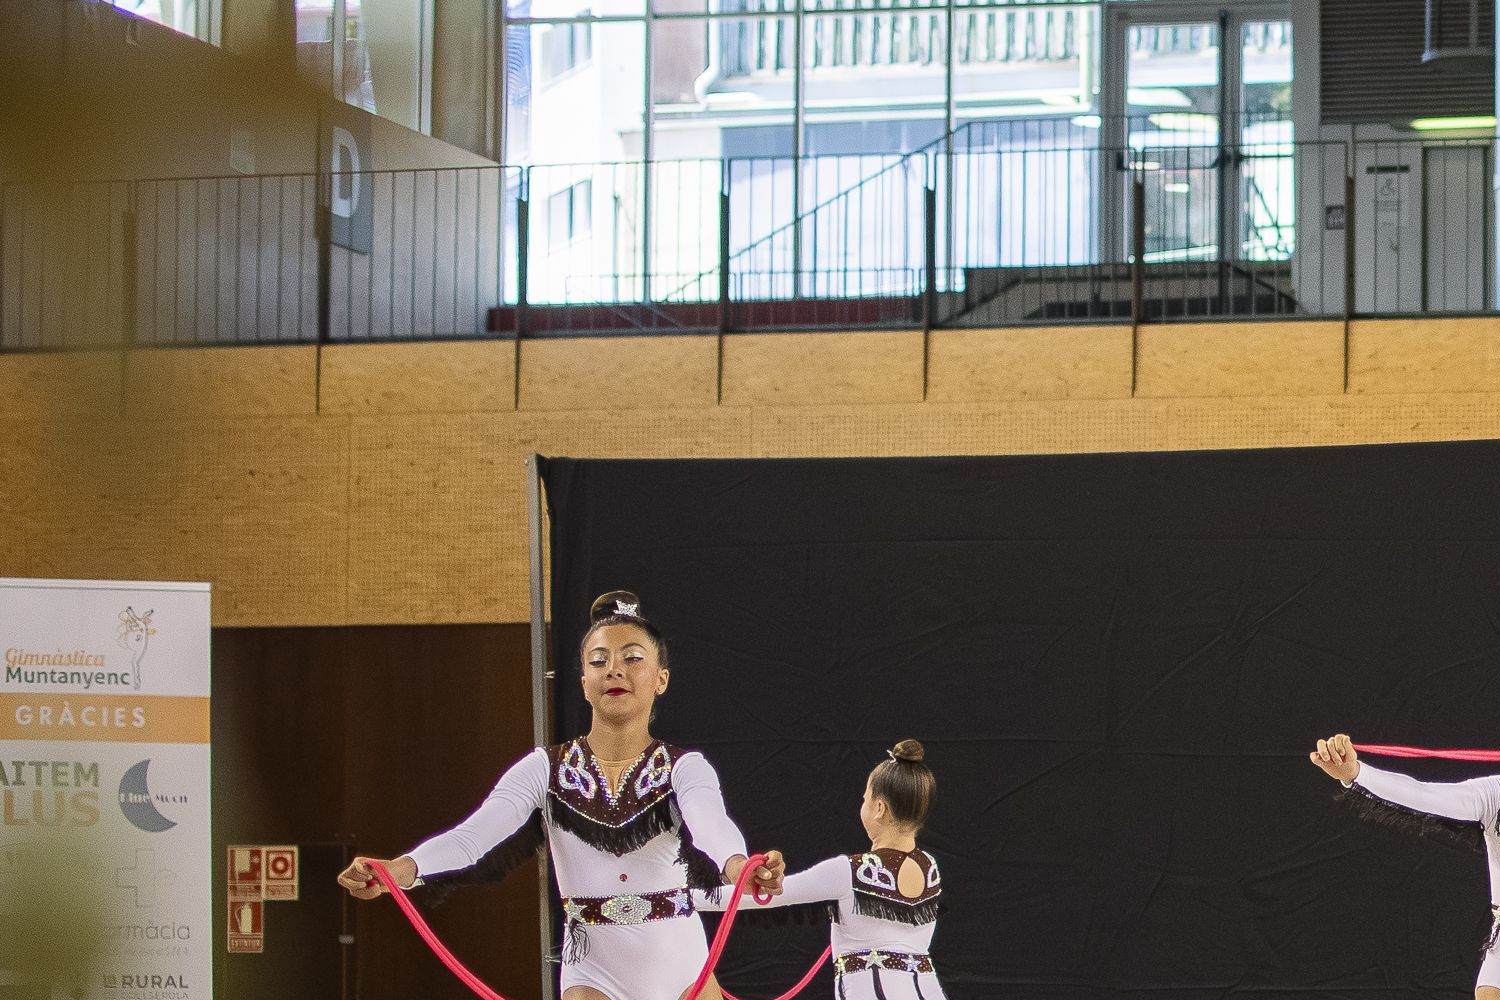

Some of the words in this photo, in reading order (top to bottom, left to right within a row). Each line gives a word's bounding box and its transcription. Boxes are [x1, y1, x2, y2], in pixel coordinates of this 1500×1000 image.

[5, 667, 130, 689] Muntanyenc
[15, 701, 146, 728] GRÀCIES
[121, 975, 189, 989] RURAL
